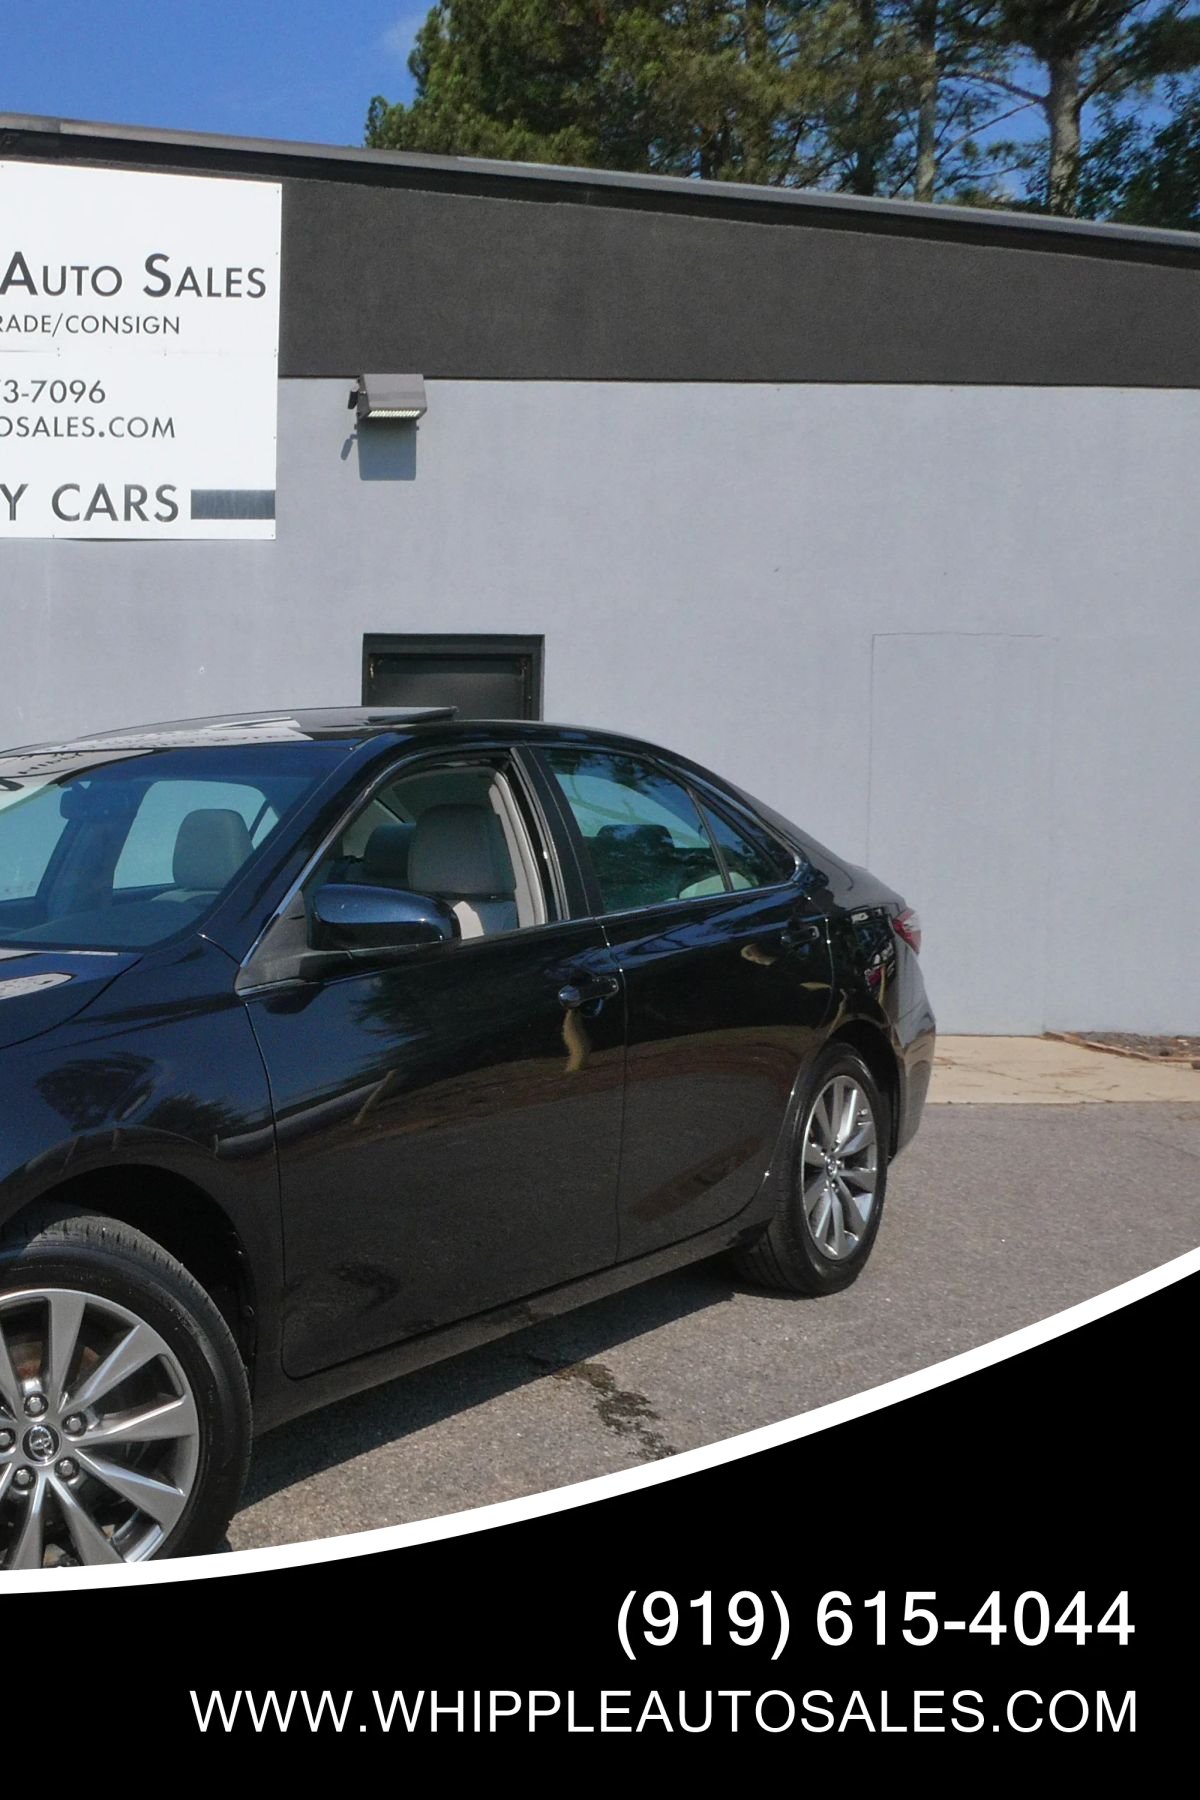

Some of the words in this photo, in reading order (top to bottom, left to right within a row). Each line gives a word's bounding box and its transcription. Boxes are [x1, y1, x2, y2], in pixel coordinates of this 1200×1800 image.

[0, 250, 123, 298] AUTO
[143, 253, 267, 299] SALES
[51, 483, 179, 523] CARS
